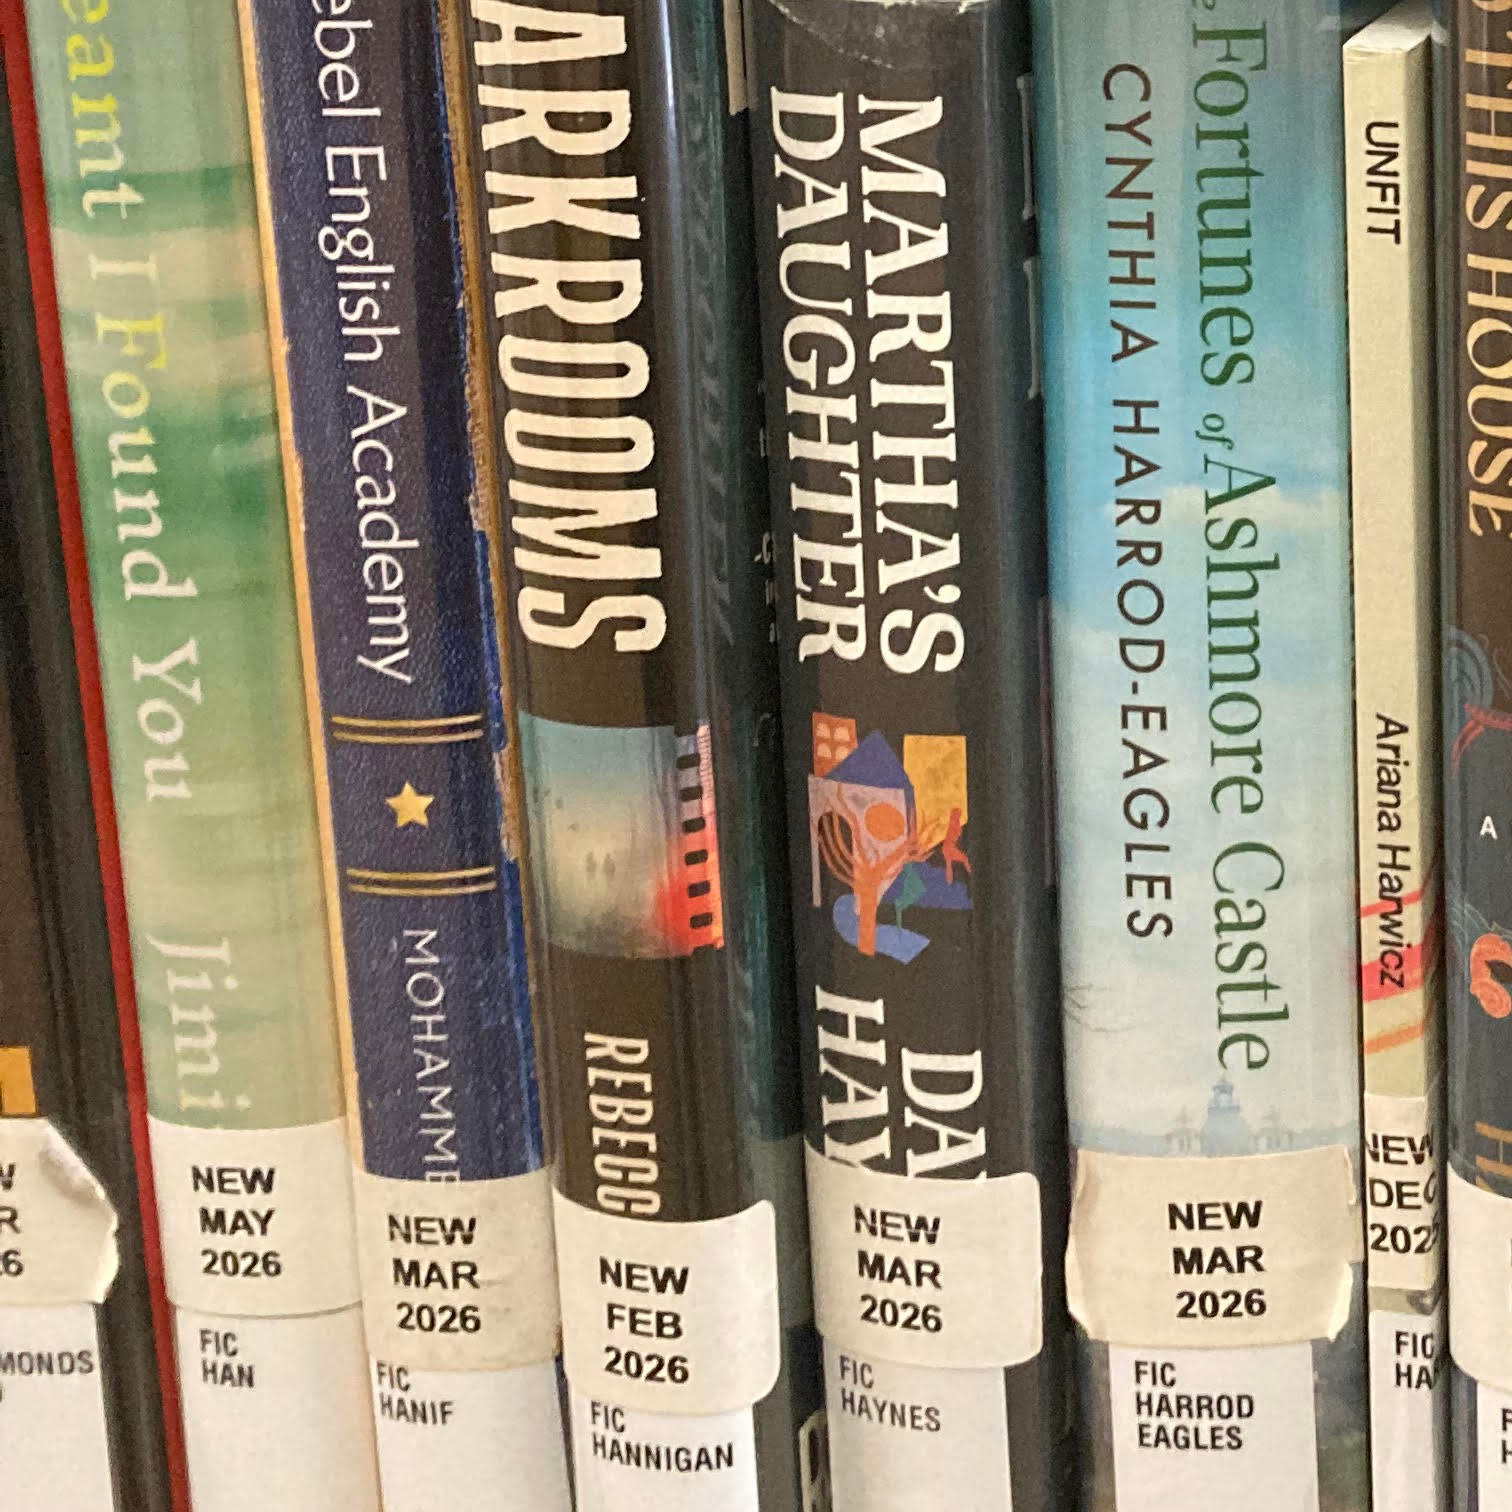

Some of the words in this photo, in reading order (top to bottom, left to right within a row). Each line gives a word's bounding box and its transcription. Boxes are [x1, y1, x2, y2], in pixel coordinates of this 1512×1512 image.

[1364, 120, 1401, 245] UNFIT
[1102, 62, 1160, 363] CYNTHIA
[1191, 20, 1269, 387] Fortunes
[89, 254, 157, 280] I
[317, 145, 400, 362] English
[770, 85, 870, 663] DAUGHTER
[857, 92, 966, 675] MARTHA'S
[1195, 411, 1235, 449] of
[97, 311, 198, 601] Found
[347, 385, 419, 684] Academy
[1203, 458, 1281, 816] Ashmore
[1112, 399, 1174, 939] HARROD-EAGLES
[132, 637, 204, 803] You
[1376, 712, 1410, 834] Ariana
[1479, 815, 1498, 840] A
[1377, 843, 1412, 989] Harwicz
[1210, 840, 1290, 1072] Castle
[901, 1048, 987, 1181] DA
[191, 1165, 276, 1195] NEW
[200, 1207, 276, 1237] MAY
[387, 1214, 476, 1246] NEW
[854, 1205, 940, 1245] NEW
[1168, 1200, 1263, 1231] NEW
[201, 1249, 282, 1279] 2026
[392, 1257, 480, 1290] MAR
[600, 1256, 689, 1296] NEW
[858, 1249, 942, 1289] MAR
[1172, 1245, 1265, 1275] MAR
[397, 1302, 481, 1334] 2026
[606, 1303, 683, 1340] FEB
[860, 1294, 943, 1333] 2026
[1175, 1288, 1267, 1319] 2026
[200, 1329, 238, 1357] FIC
[201, 1359, 255, 1389] HAN
[377, 1361, 411, 1391] FIC
[604, 1346, 689, 1385] 2026
[839, 1354, 874, 1389] FIC
[1134, 1360, 1176, 1387] FIC
[380, 1394, 454, 1426] HANIF
[590, 1401, 626, 1434] FIC
[841, 1390, 941, 1433] HAYNES
[1136, 1392, 1255, 1419] HARROD
[592, 1434, 733, 1474] HANNIGAN
[1138, 1422, 1243, 1451] EAGLES
